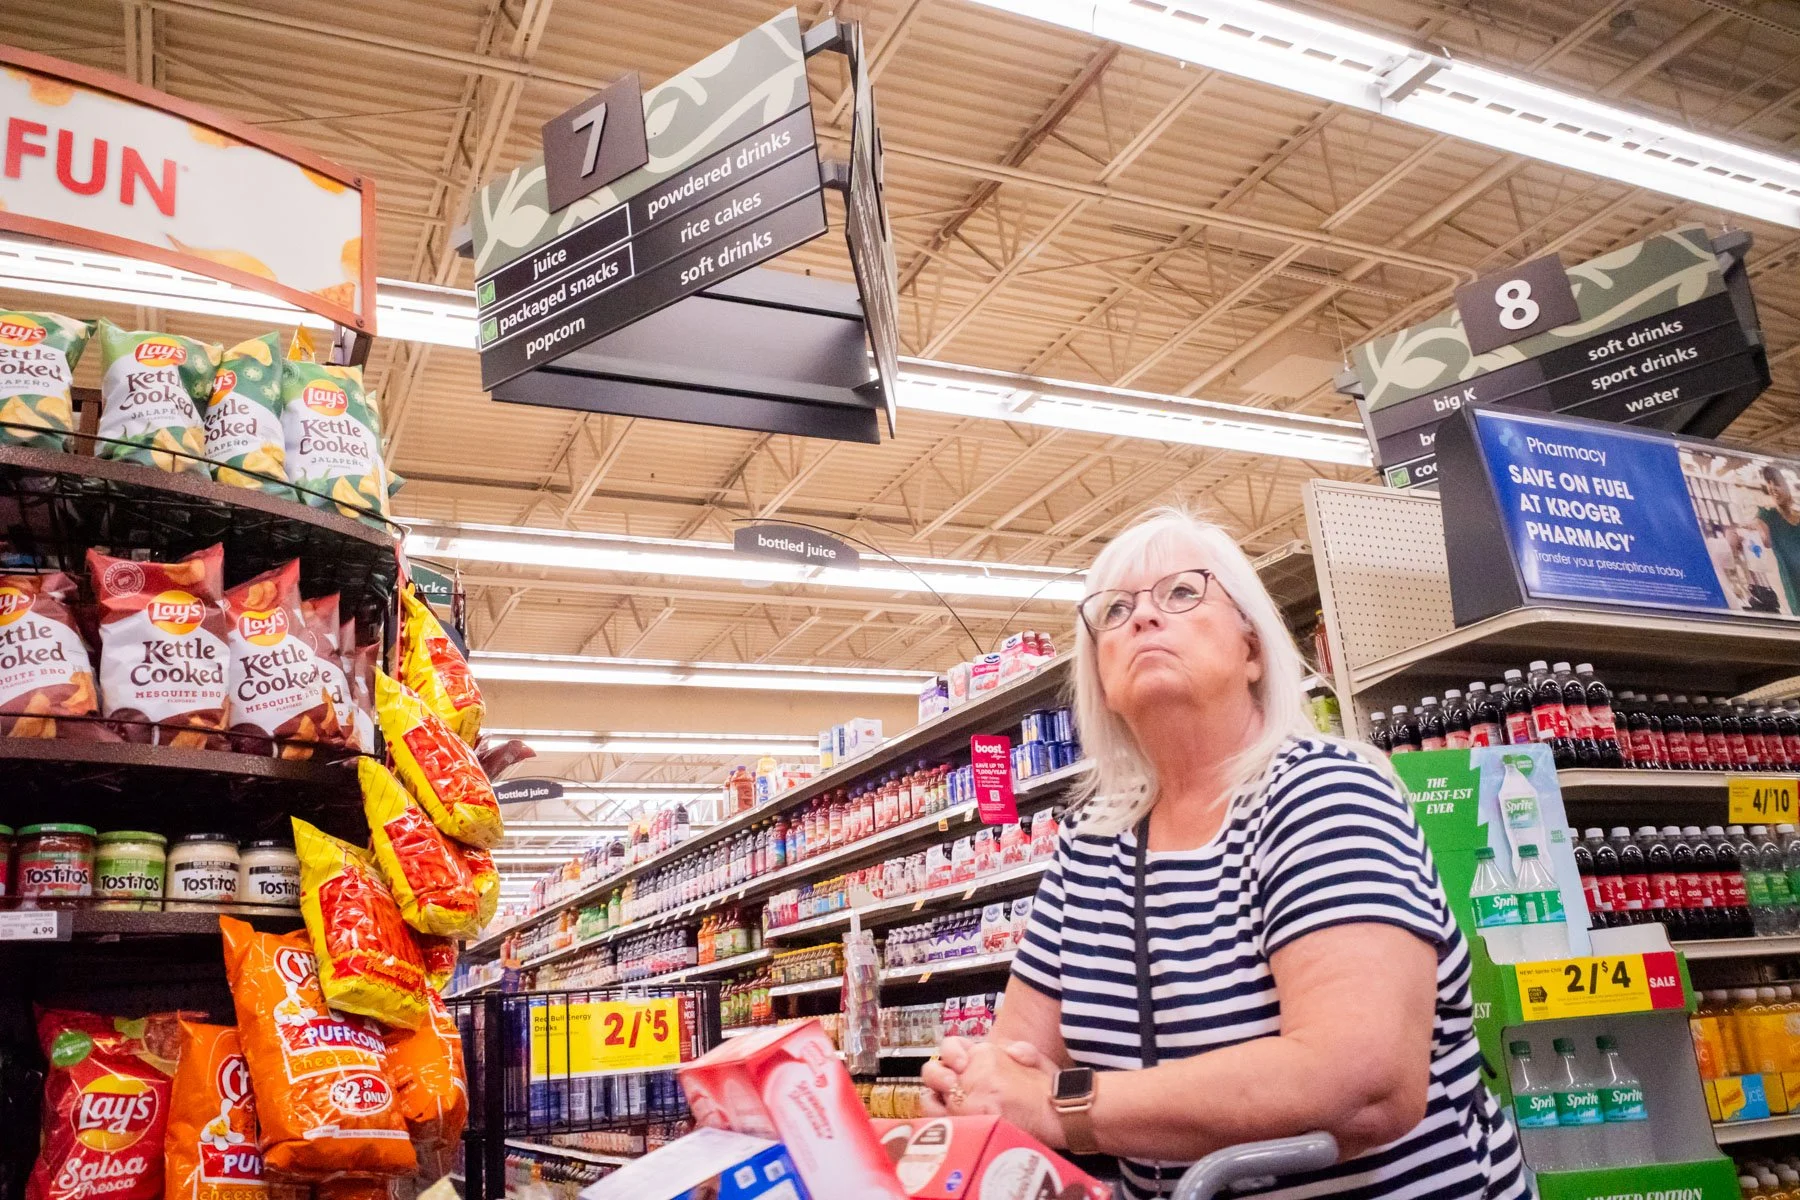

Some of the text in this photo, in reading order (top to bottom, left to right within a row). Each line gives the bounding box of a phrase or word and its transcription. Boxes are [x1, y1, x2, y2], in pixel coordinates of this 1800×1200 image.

[572, 101, 607, 178] 7
[4, 116, 177, 217] FUN
[647, 128, 792, 220] powdered drinks
[680, 190, 762, 244] rice cakes
[532, 247, 567, 280] juice
[680, 229, 773, 286] soft drinks
[500, 260, 619, 335] packaged snacks
[1494, 278, 1540, 330] 8
[526, 315, 586, 359] popcorn
[1587, 317, 1684, 362] soft drinks
[1591, 344, 1698, 391] sport drinks
[1433, 387, 1476, 413] big K
[1625, 385, 1681, 414] water
[301, 419, 362, 438] Kettle
[299, 436, 369, 459] Cooked
[1527, 435, 1607, 467] Pharmacy
[1508, 464, 1634, 501] SAVE ON FUEL
[1520, 493, 1623, 526] AT KROGER
[757, 534, 837, 560] bottled juice
[1533, 550, 1686, 579] Transfer your prescriptions today.
[152, 601, 201, 624] Lay's
[243, 609, 285, 636] Lay's
[142, 637, 215, 666] Kettle
[239, 644, 308, 679] Kettle
[130, 660, 223, 687] Cooked
[135, 690, 198, 699] MESQUITE
[246, 693, 303, 713] MESQUITE
[975, 740, 1002, 754] boost
[498, 786, 549, 800] bottled juice
[1408, 788, 1473, 802] OLDEST-EST
[1427, 777, 1448, 788] THE
[1426, 803, 1454, 814] EVER
[1505, 800, 1534, 814] Sprite
[32, 926, 54, 935] 4.99
[1564, 960, 1631, 995] 2/$4
[1650, 975, 1676, 989] SALE
[550, 1014, 565, 1022] Bull
[604, 1009, 669, 1049] 2/$5
[308, 1024, 386, 1055] PUFFCORN
[362, 1090, 388, 1103] ONLY
[78, 1091, 153, 1135] Lay's
[58, 1155, 149, 1190] Salsa
[73, 1176, 137, 1200] Fresca
